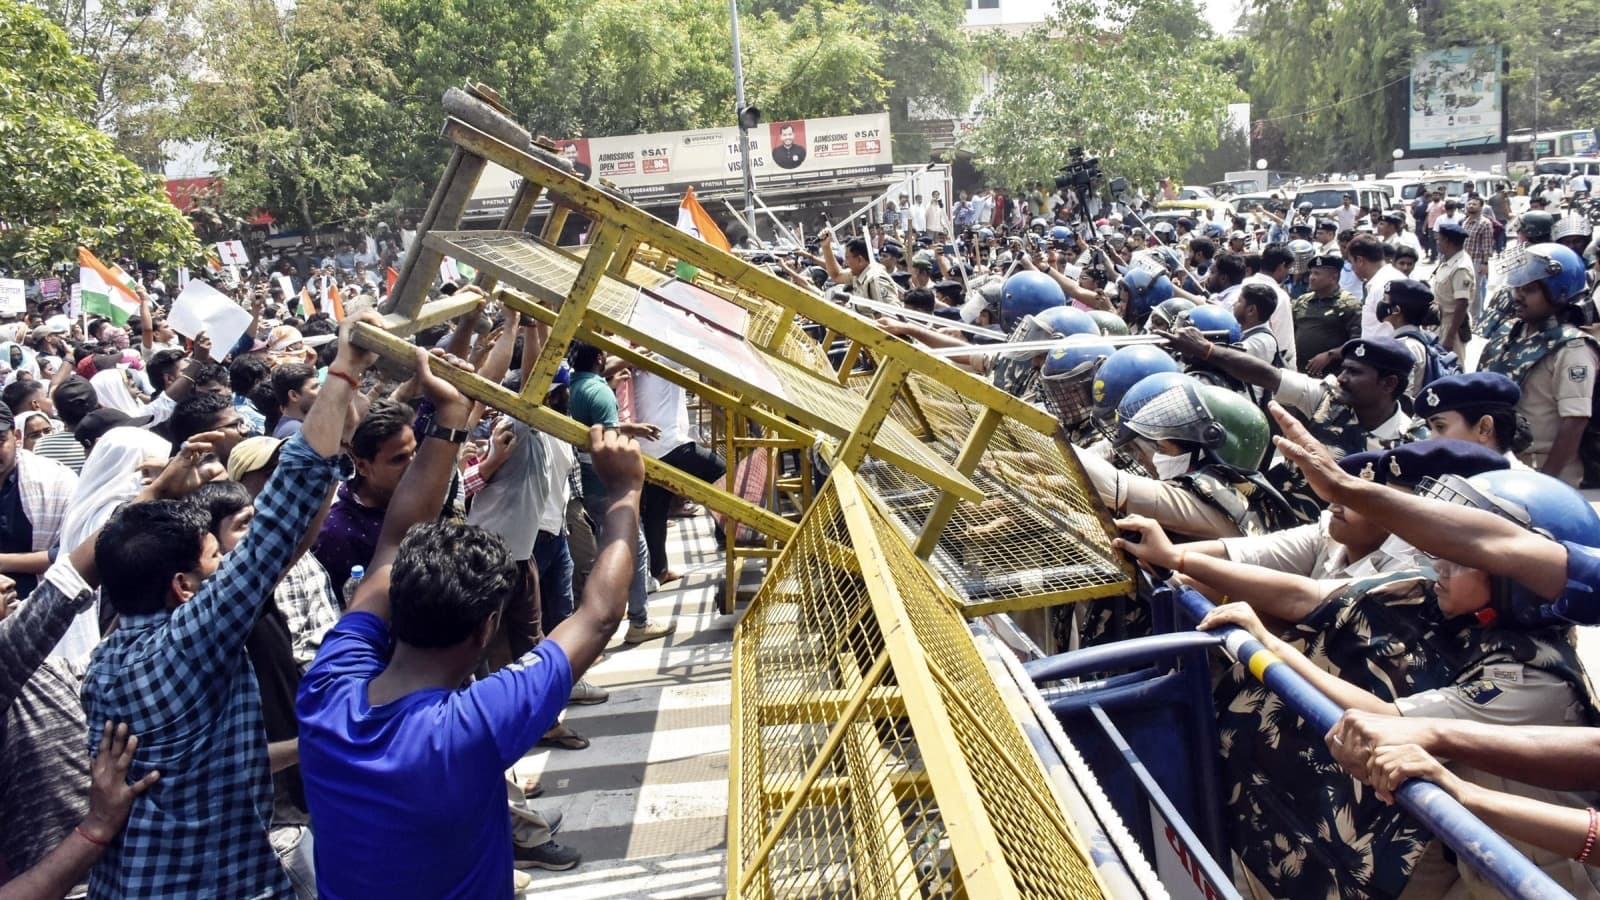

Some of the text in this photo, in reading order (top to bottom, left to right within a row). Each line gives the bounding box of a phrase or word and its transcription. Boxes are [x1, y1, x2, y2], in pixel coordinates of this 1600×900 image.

[814, 133, 848, 143] ADMISSIONS
[862, 129, 880, 138] SAT
[648, 148, 667, 157] SAT
[814, 144, 829, 152] OPEN
[598, 152, 634, 162] ADMISSIONS
[600, 162, 615, 170] OPEN
[728, 157, 764, 171] VISAS
